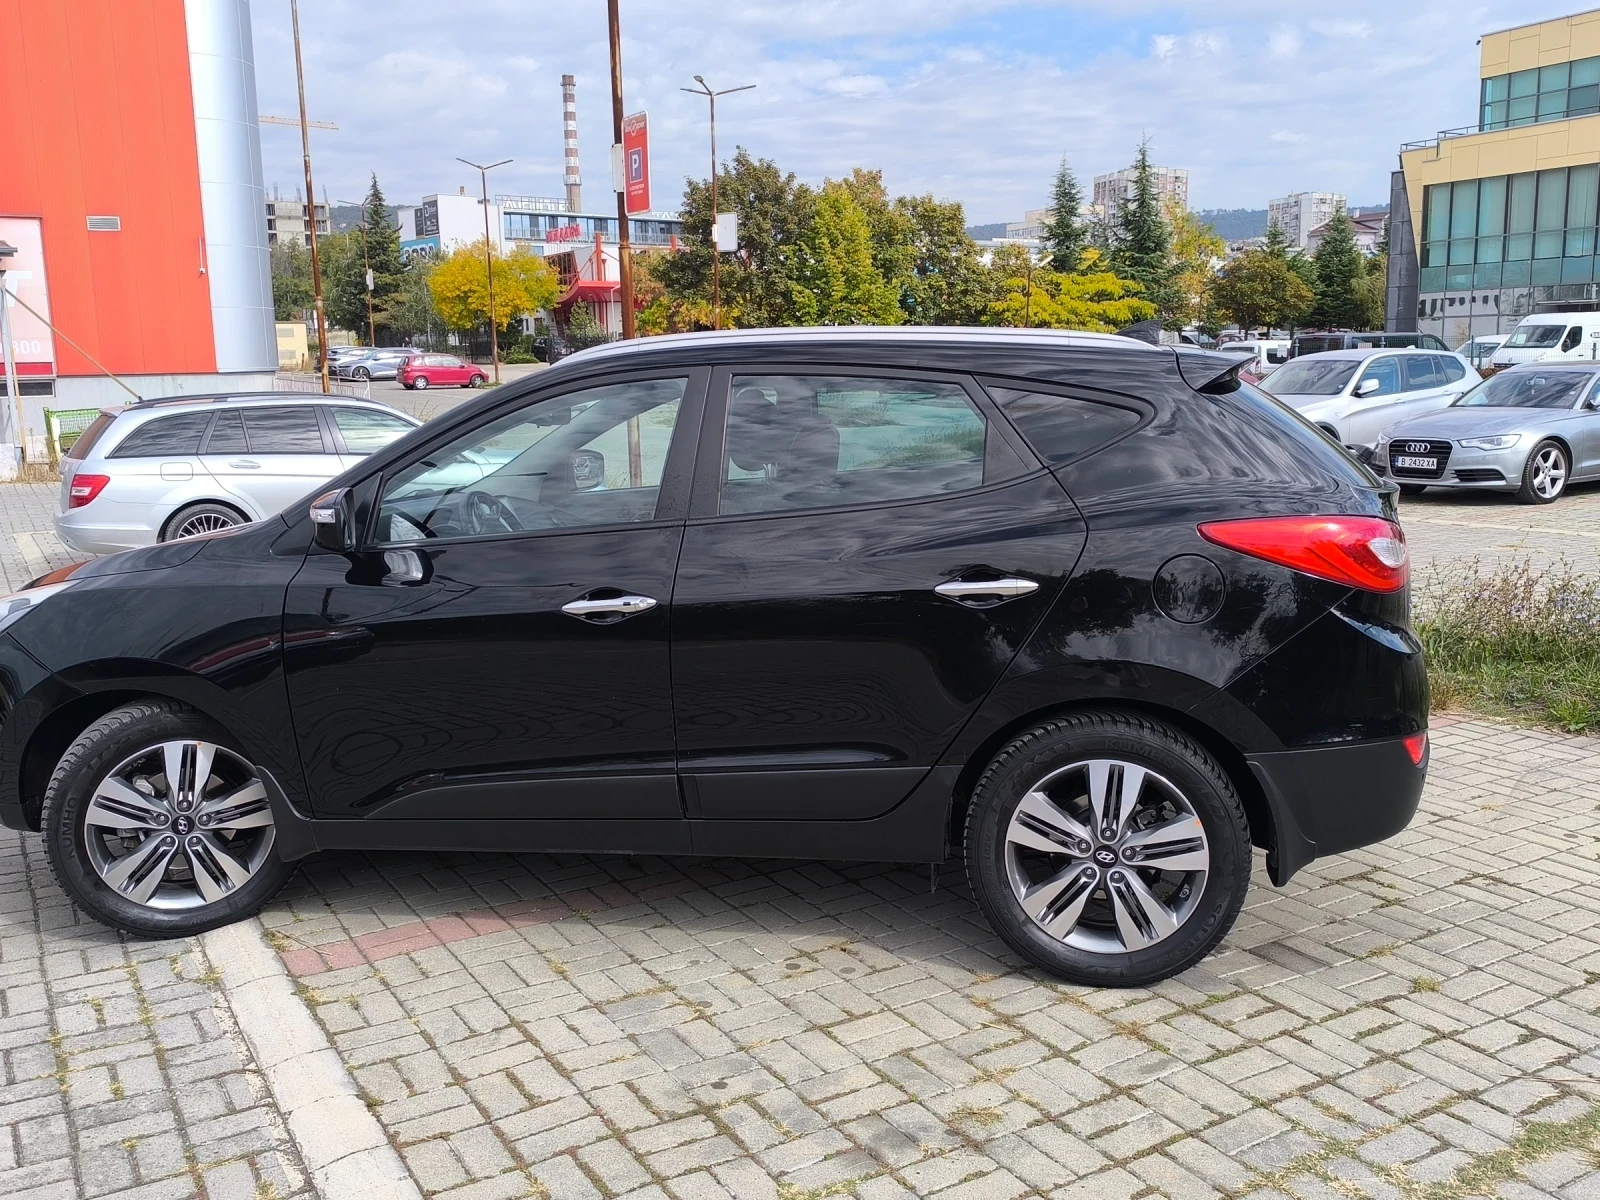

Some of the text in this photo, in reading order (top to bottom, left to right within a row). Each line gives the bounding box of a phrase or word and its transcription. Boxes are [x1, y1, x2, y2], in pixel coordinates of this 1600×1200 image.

[632, 154, 640, 177] P
[1401, 457, 1406, 466] B
[1104, 740, 1178, 769] KUMHO
[62, 796, 78, 860] KUMHO
